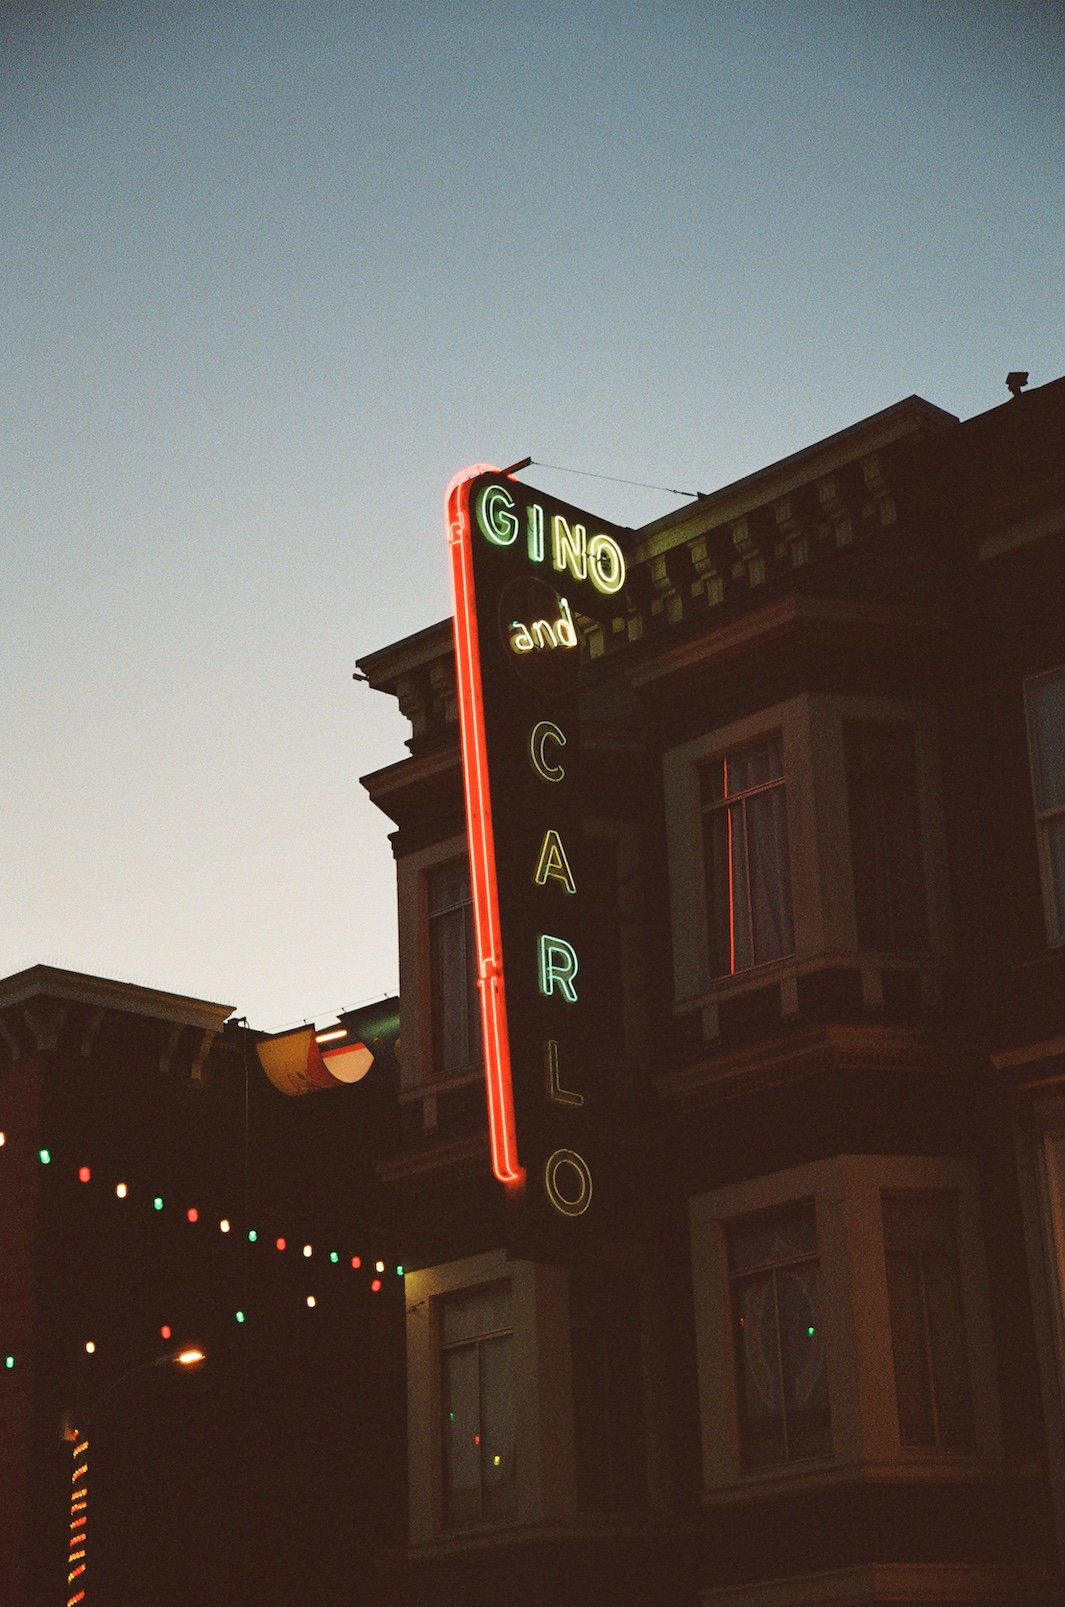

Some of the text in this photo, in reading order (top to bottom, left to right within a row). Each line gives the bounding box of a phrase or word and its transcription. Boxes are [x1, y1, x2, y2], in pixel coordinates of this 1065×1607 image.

[475, 484, 626, 595] GINO
[509, 597, 578, 653] and
[530, 720, 594, 1217] CARLO
